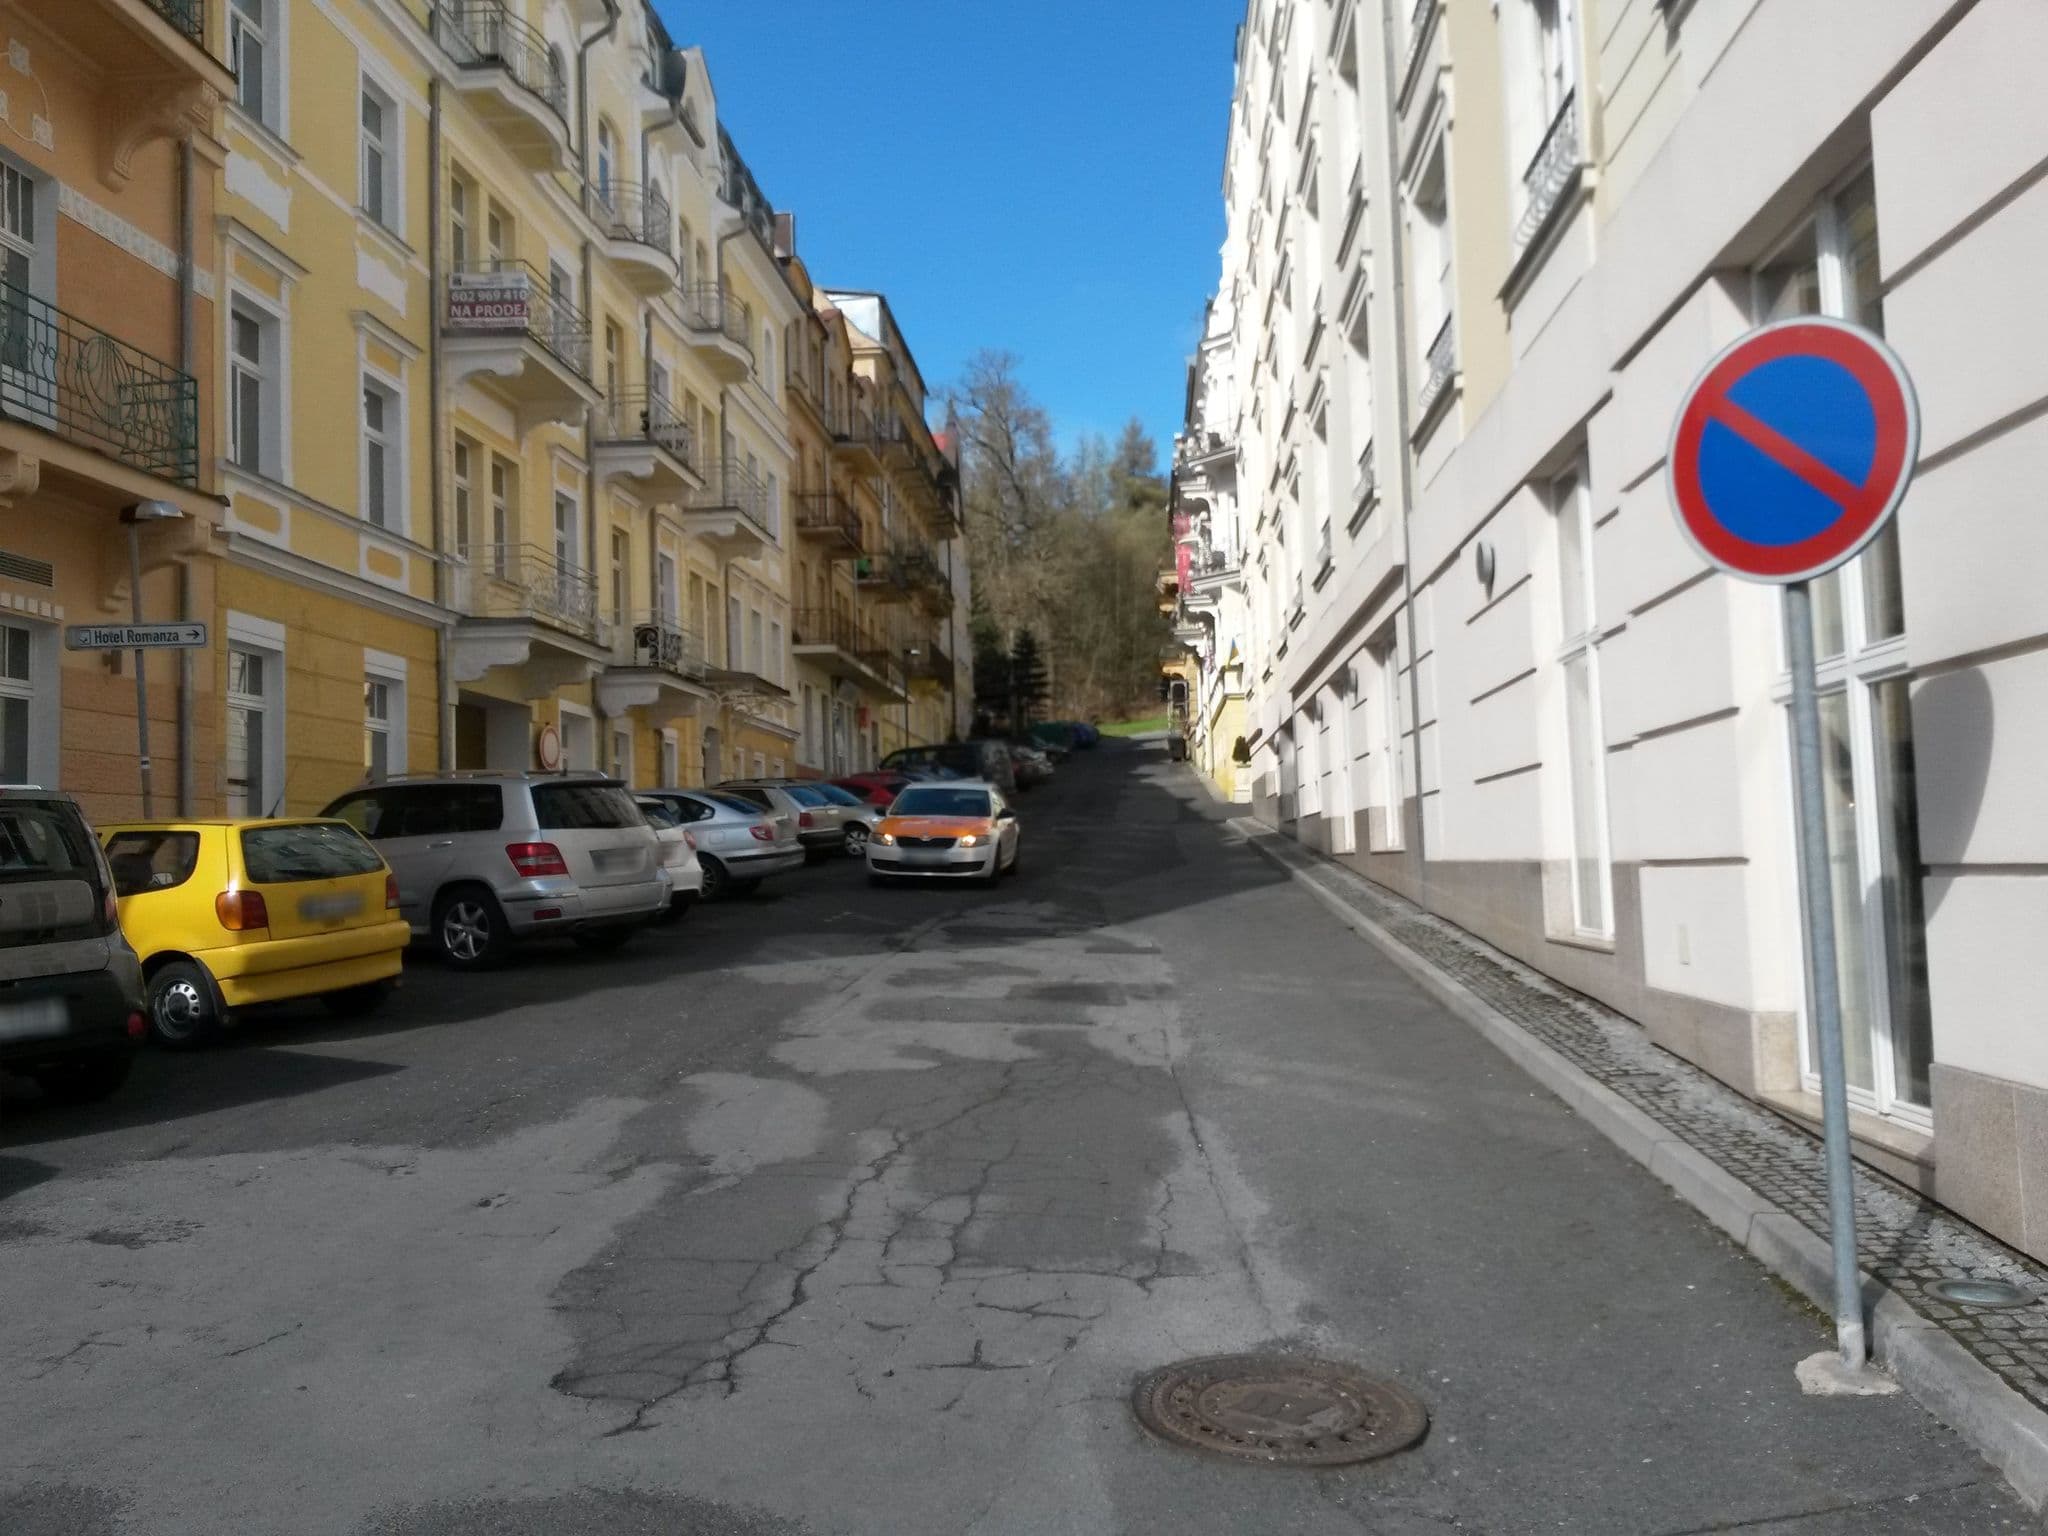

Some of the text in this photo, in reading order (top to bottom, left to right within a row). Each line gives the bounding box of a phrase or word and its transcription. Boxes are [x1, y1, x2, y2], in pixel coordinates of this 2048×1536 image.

[451, 303, 527, 317] NA PRODEJ
[95, 629, 180, 644] Hotel Romanza
